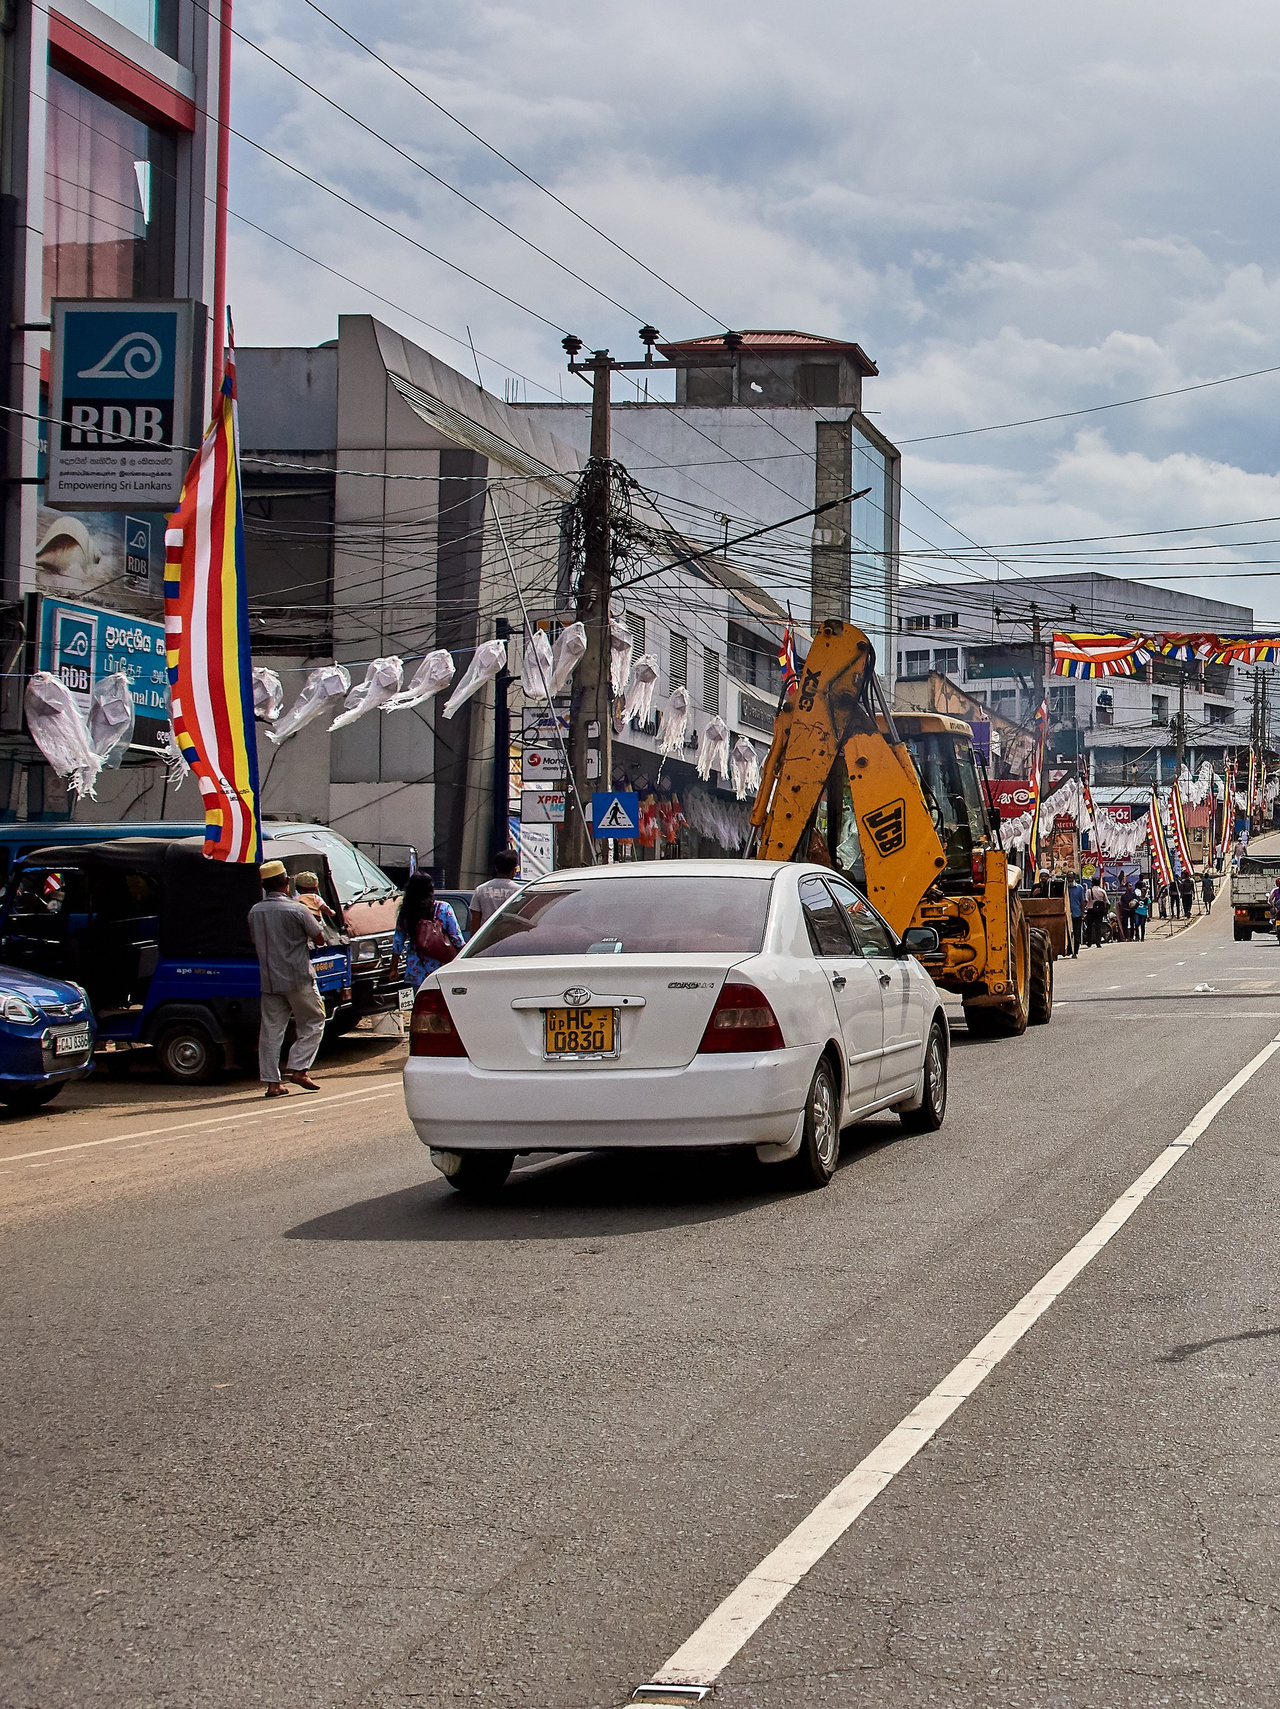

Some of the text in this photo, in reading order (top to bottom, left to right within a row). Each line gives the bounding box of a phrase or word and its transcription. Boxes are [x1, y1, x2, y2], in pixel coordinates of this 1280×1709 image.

[70, 405, 163, 444] RDB
[59, 481, 172, 492] Empowering Sri Lankans
[127, 555, 147, 575] RDB
[60, 666, 88, 689] RDB
[866, 806, 904, 853] JCB
[549, 1020, 565, 1031] UP
[567, 1010, 593, 1030] HC
[554, 1030, 604, 1051] 0830
